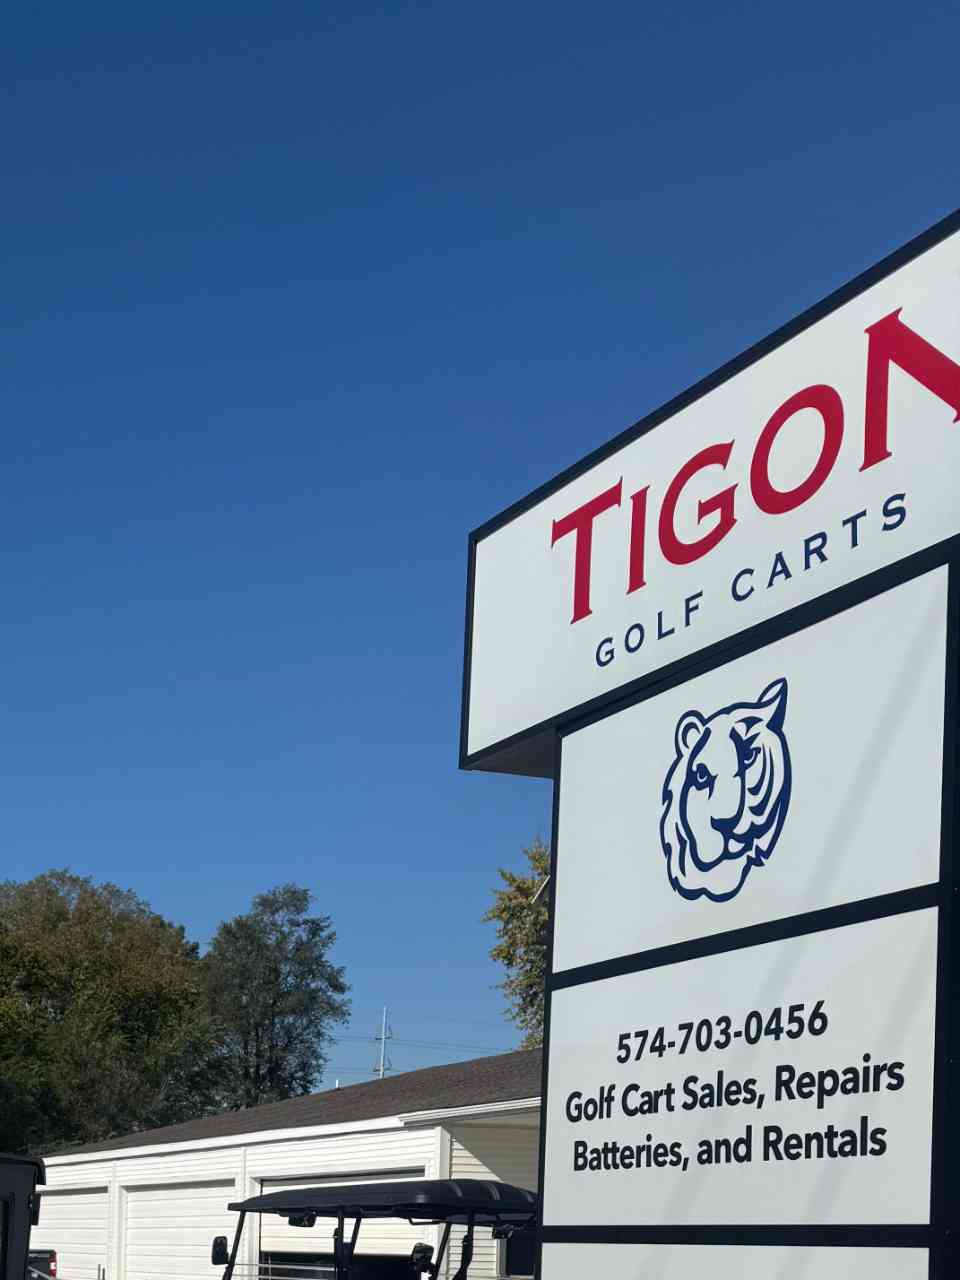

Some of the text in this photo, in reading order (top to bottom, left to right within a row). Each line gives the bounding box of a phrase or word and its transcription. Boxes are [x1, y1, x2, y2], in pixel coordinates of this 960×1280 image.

[551, 307, 960, 625] TIGON
[595, 492, 908, 668] GOLF CARTS
[615, 999, 829, 1064] 574-703-0456
[565, 1052, 906, 1123] Golf Cart Sales, Repairs
[573, 1115, 888, 1172] Batteries, and Rentals
